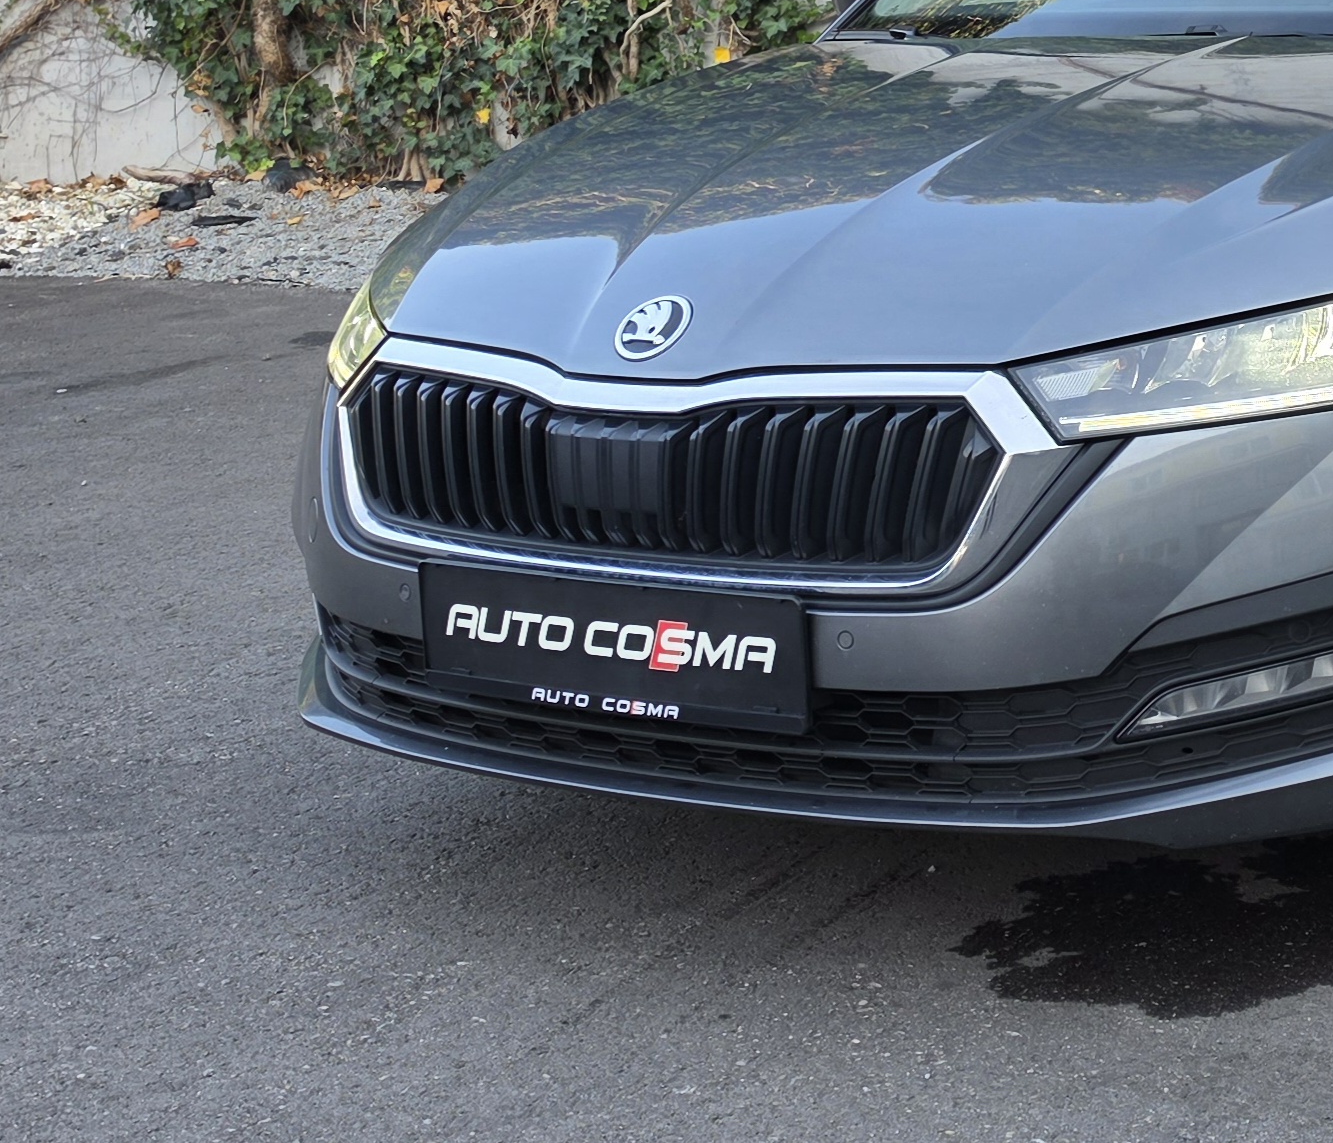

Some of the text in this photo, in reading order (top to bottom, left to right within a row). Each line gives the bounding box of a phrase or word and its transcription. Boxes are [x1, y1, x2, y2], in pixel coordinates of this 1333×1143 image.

[445, 603, 777, 674] AUTO COSMA
[531, 687, 680, 720] AUTO COSMA
